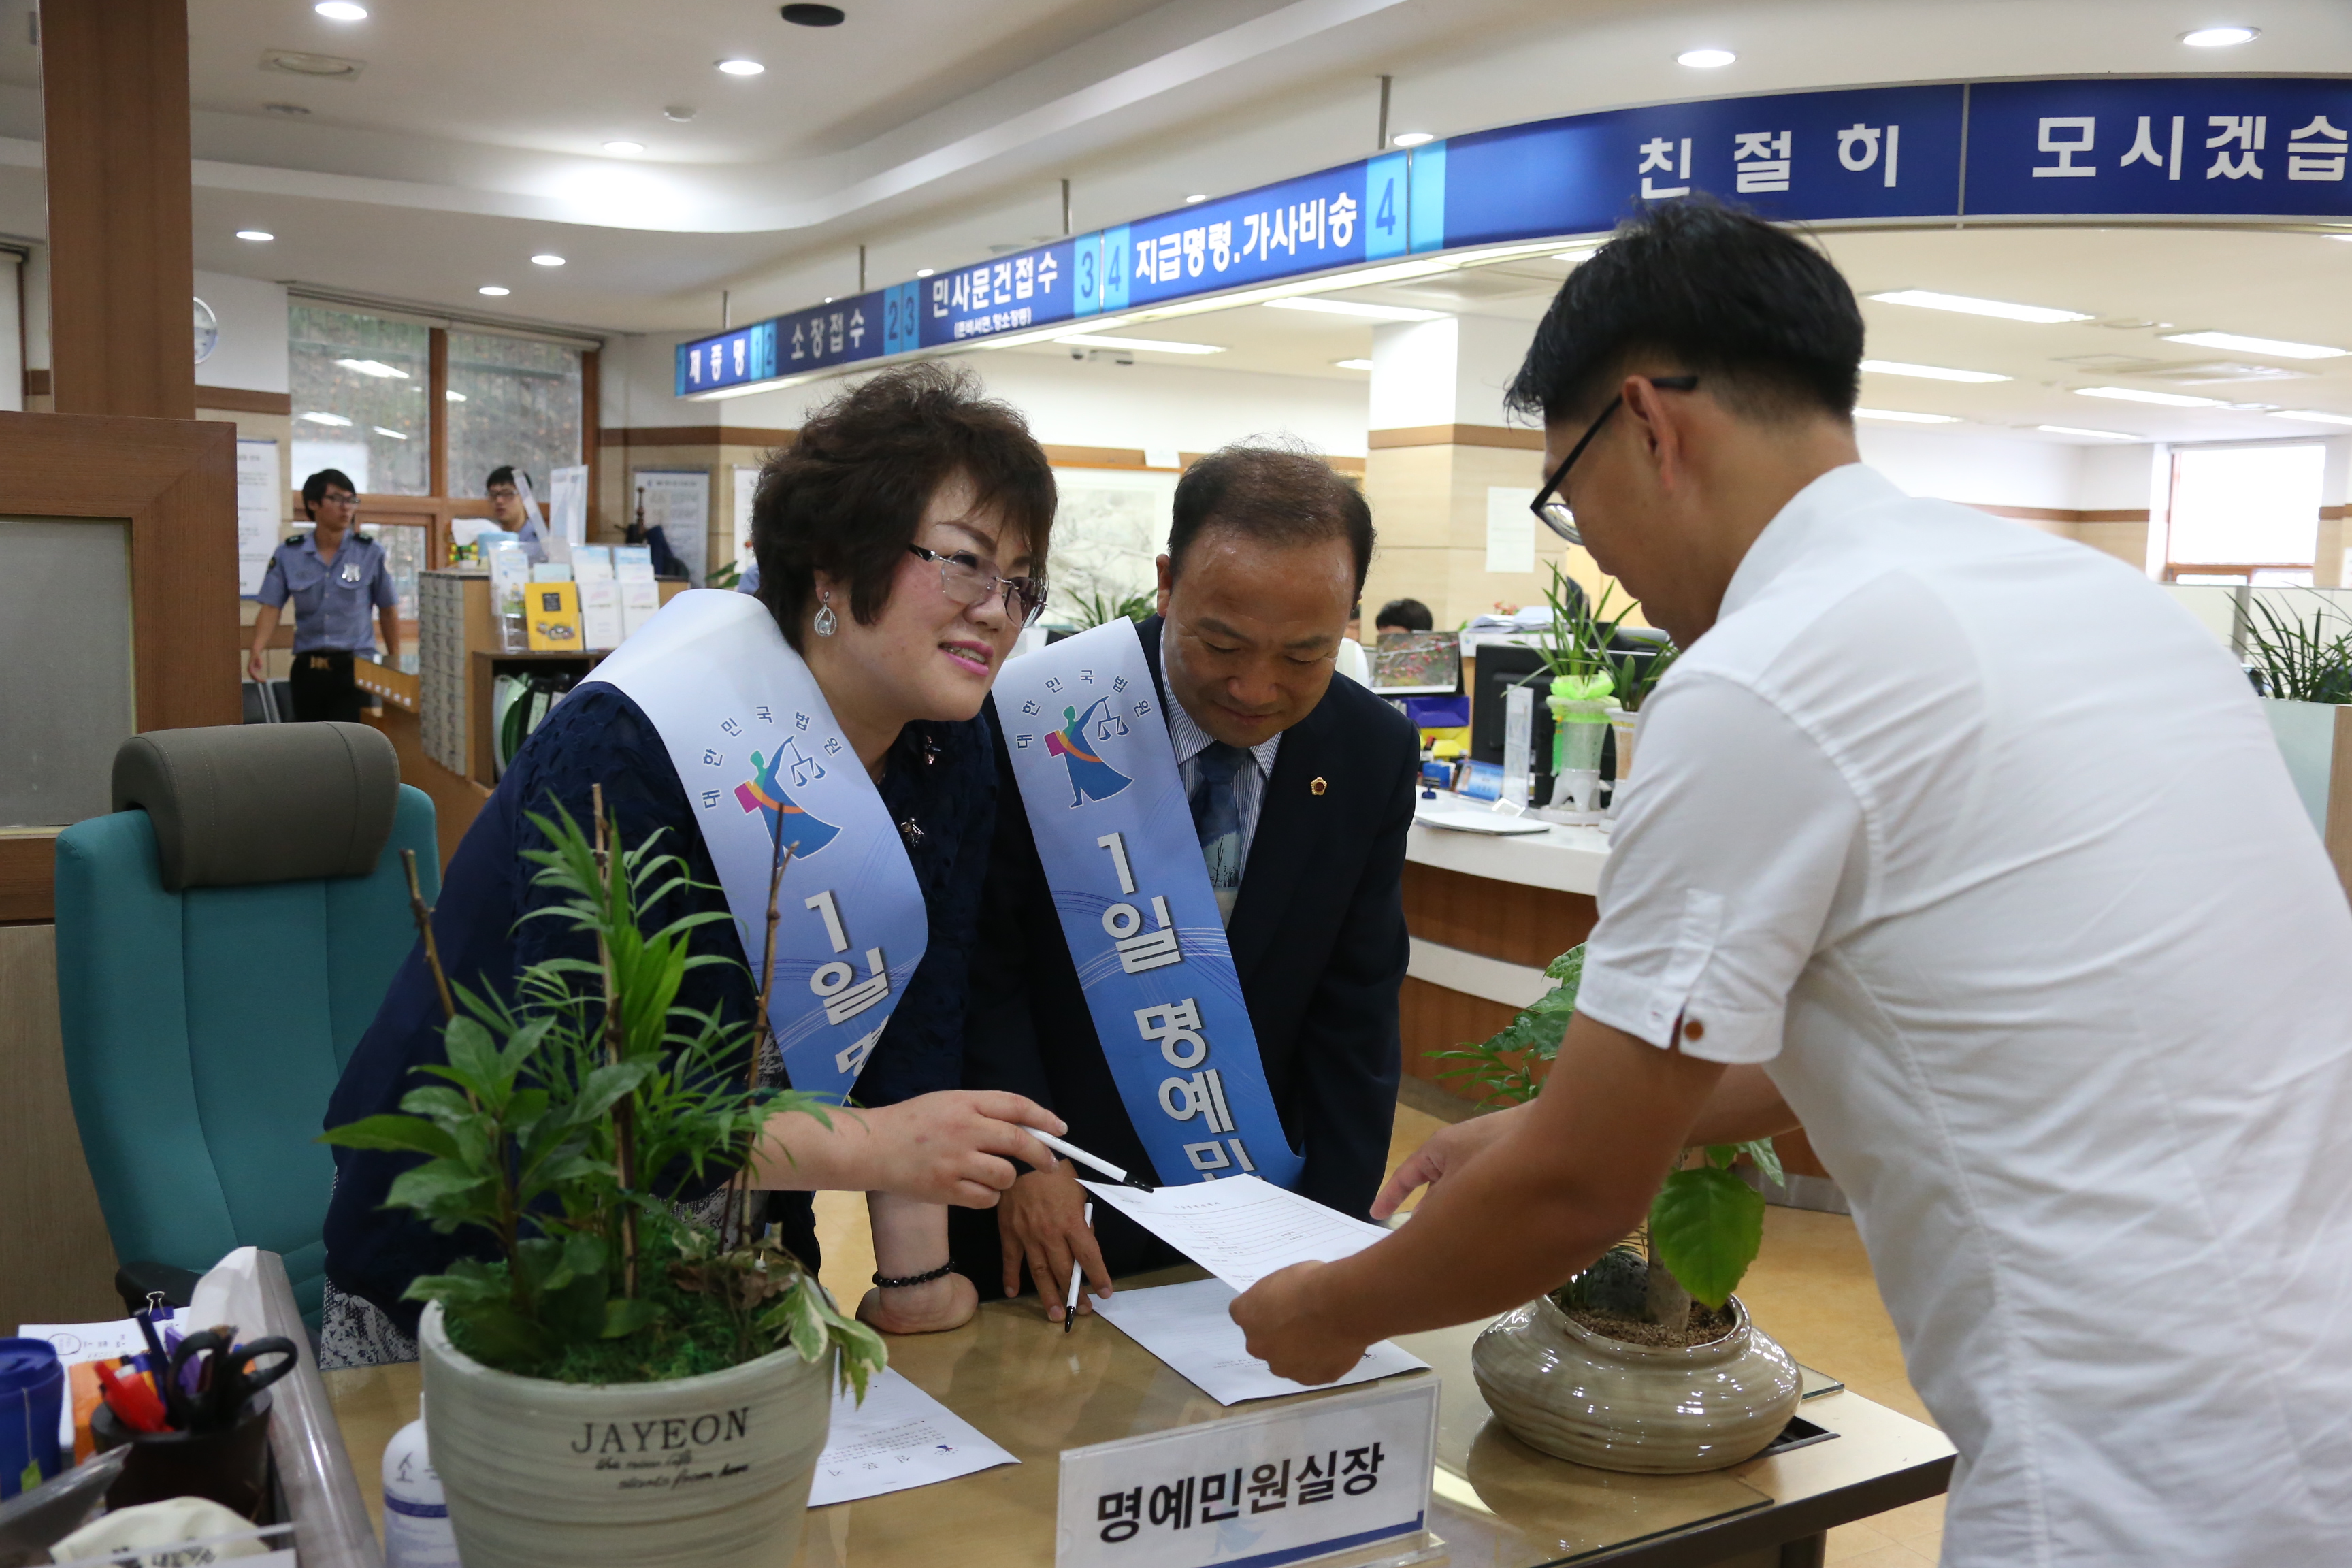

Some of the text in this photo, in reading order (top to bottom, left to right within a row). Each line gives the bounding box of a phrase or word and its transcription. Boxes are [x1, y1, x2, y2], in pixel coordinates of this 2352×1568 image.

[2032, 115, 2349, 182] 모시겠습
[1375, 177, 1396, 235] 4
[933, 250, 1058, 318] 민사문건접수
[1081, 250, 1094, 298] 3
[1108, 246, 1121, 291] 4
[791, 306, 865, 361] 소장접수
[889, 301, 898, 340] 2
[904, 296, 915, 336] 3
[1097, 832, 1182, 974] 1일
[804, 889, 889, 1026] 1일
[571, 1407, 749, 1454] JAYEON
[1097, 1441, 1385, 1544] 명예민원실장
